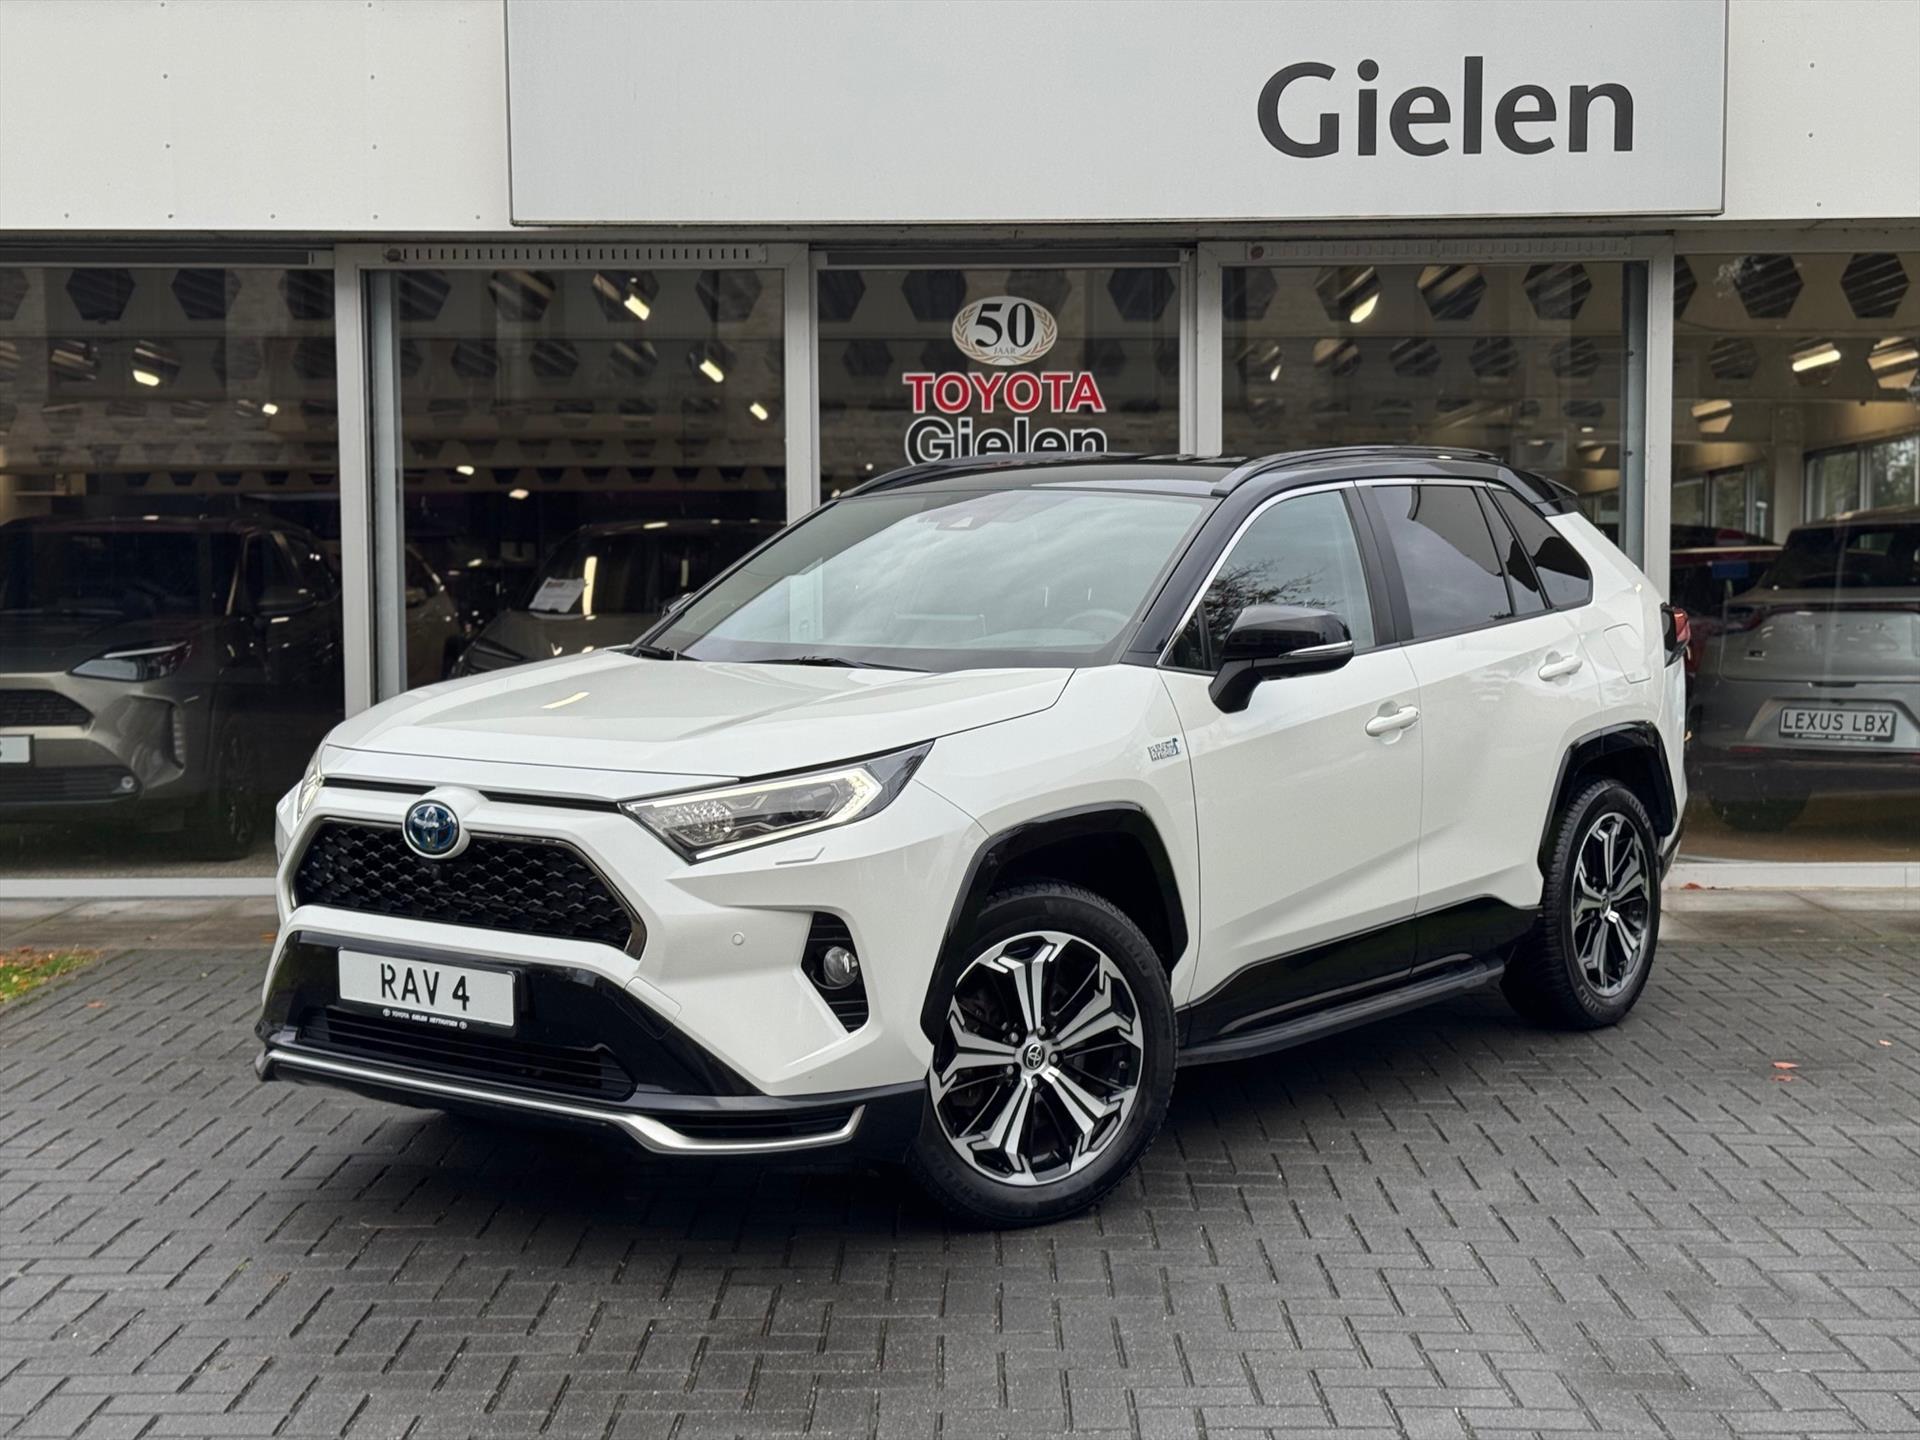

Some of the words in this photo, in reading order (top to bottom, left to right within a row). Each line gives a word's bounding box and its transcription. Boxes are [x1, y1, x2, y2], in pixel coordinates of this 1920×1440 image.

[1257, 55, 1634, 158] Gielen
[975, 302, 1035, 348] 50
[993, 346, 1017, 355] JAAR
[902, 372, 1107, 414] TOYOTA
[905, 416, 1108, 466] Gielen
[1783, 711, 1844, 731] LEXUS
[1852, 714, 1890, 733] LBX
[380, 962, 440, 1006] RAV
[452, 975, 470, 1011] 4
